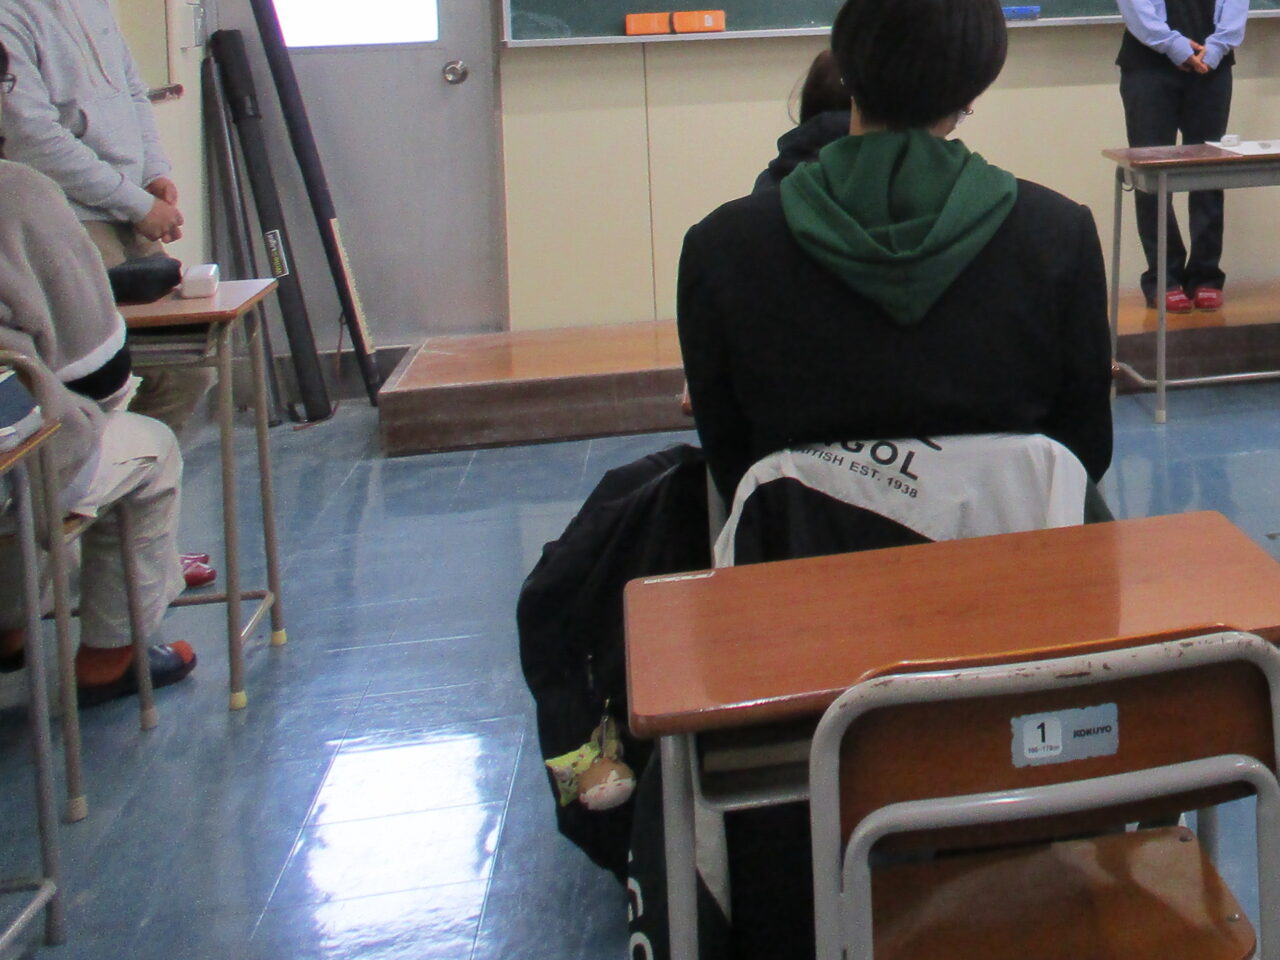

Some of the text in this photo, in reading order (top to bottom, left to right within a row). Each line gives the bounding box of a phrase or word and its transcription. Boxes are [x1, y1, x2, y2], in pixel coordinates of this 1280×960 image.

[824, 440, 919, 481] GOL
[849, 461, 881, 481] EST.
[887, 477, 919, 499] 1938
[1036, 721, 1046, 743] 1
[1073, 724, 1112, 739] KOKUYO
